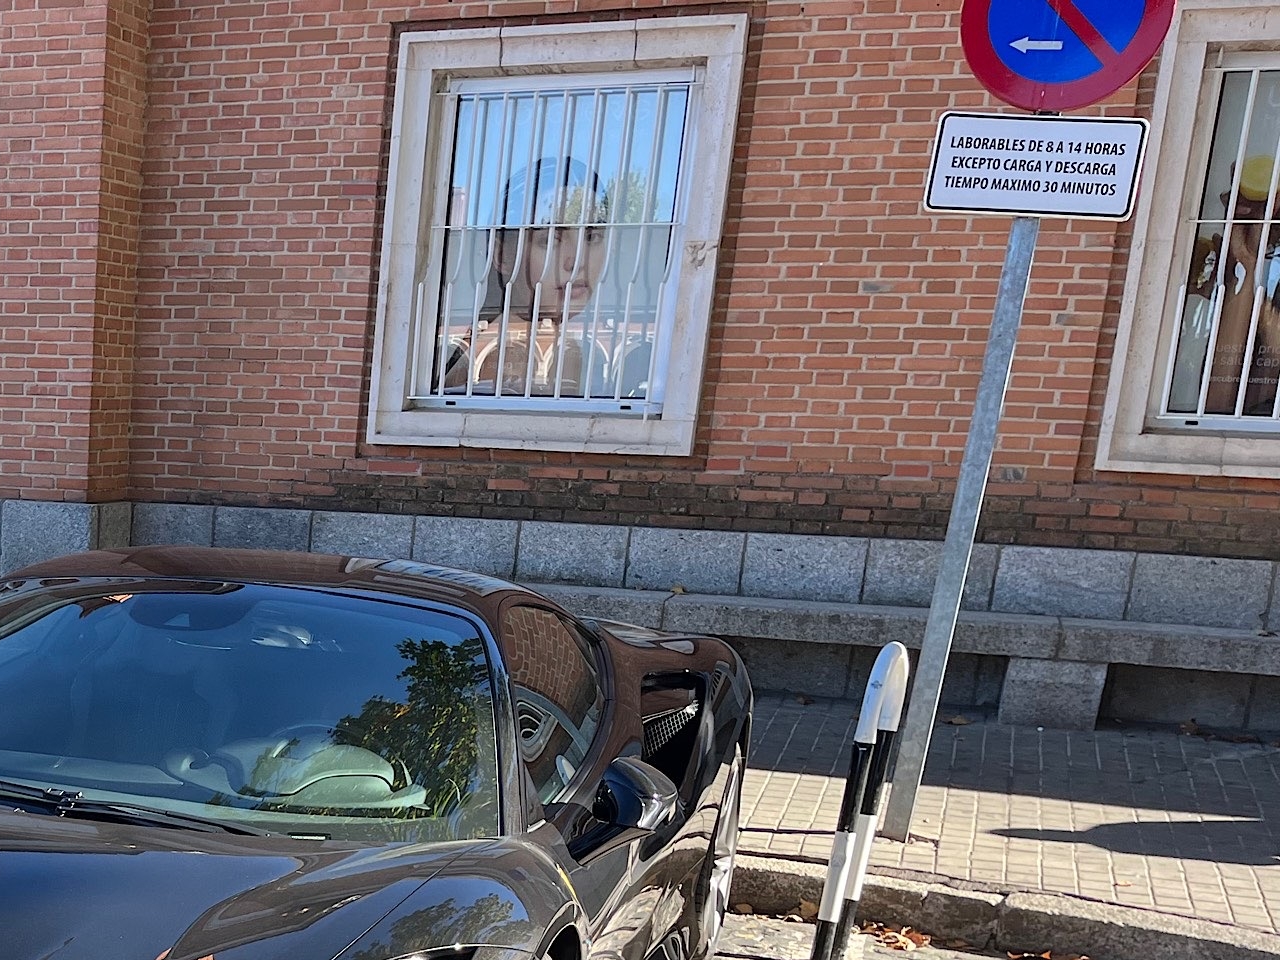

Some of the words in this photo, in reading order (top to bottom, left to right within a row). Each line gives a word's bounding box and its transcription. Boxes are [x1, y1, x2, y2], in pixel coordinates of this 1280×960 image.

[950, 136, 1025, 152] LABORABLES
[1028, 140, 1043, 153] DE
[1046, 141, 1054, 153] 8
[1055, 142, 1064, 153] A
[1069, 142, 1082, 154] 14
[1084, 142, 1126, 156] HORAS
[951, 156, 1001, 170] EXCEPTO
[1003, 159, 1042, 173] CARGA
[1045, 161, 1054, 173] Y
[1054, 162, 1116, 176] DESCARGA
[944, 176, 989, 190] TIEMPO
[990, 178, 1040, 192] MAXIMO
[1042, 181, 1058, 193] 30
[1060, 182, 1116, 196] MINUTOS
